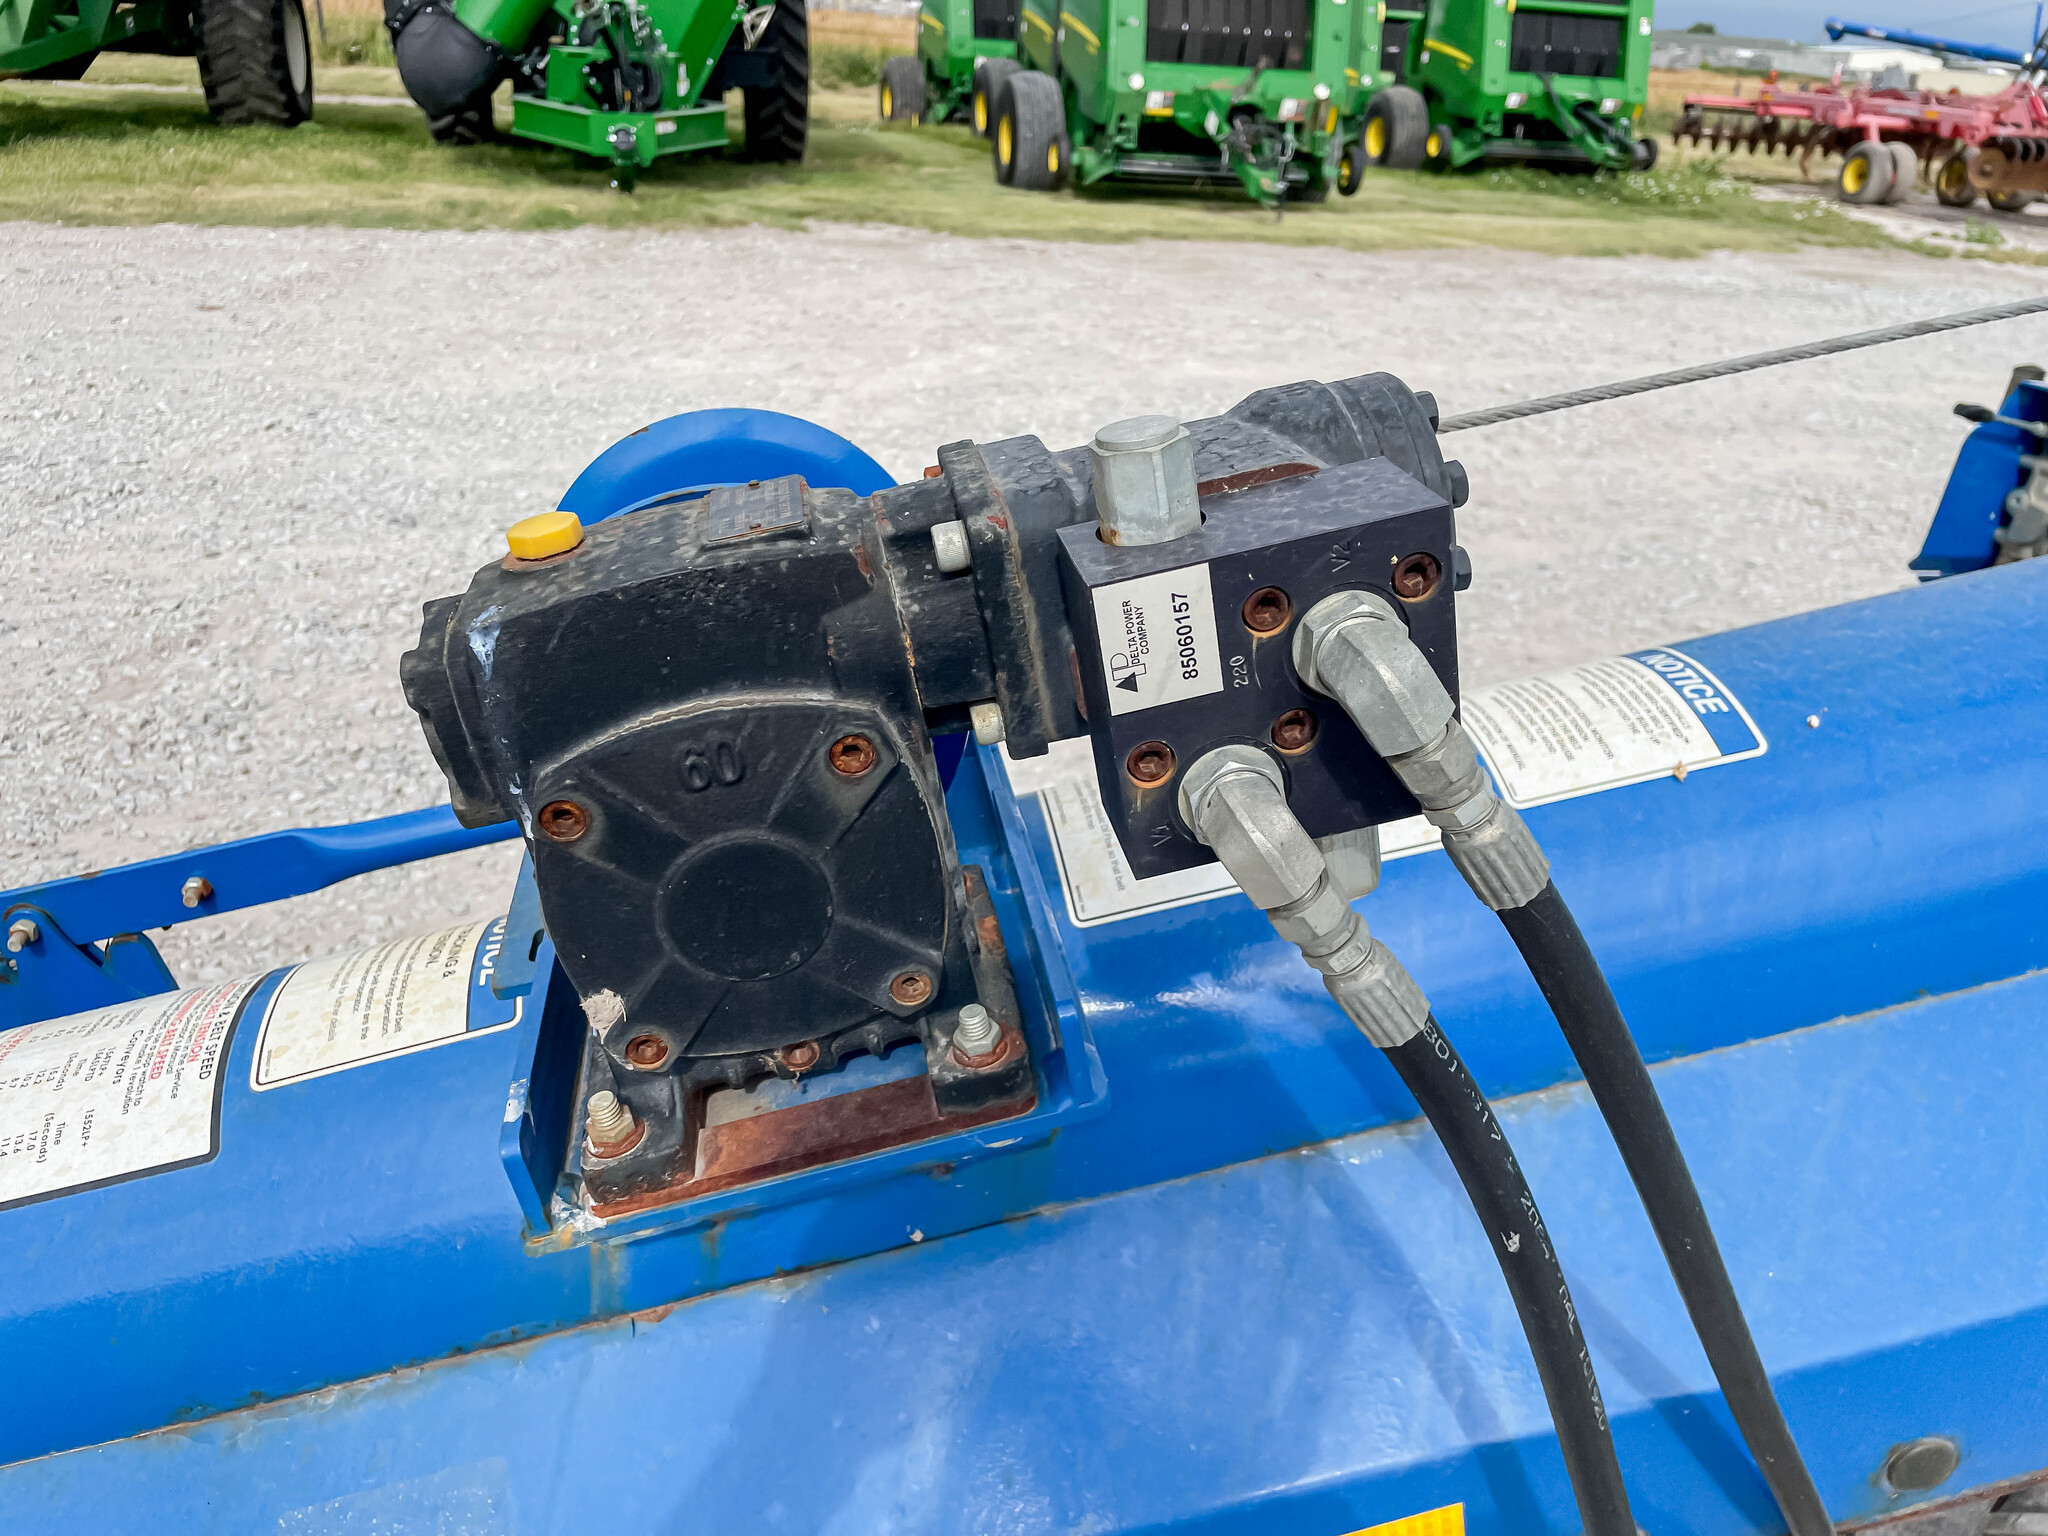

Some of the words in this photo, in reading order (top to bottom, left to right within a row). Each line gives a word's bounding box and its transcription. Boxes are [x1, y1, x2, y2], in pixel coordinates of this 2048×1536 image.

[1122, 599, 1136, 635] POWER
[1134, 606, 1150, 655] COMPANY
[1128, 636, 1141, 665] DELTA
[1171, 593, 1199, 680] 85060157
[1230, 654, 1250, 688] 220
[1639, 652, 1729, 716] NOTICE
[681, 739, 746, 792] 60
[442, 968, 455, 979] &
[159, 1027, 178, 1048] BELT
[186, 1021, 212, 1064] TENSION
[207, 1020, 225, 1042] BELT
[52, 1050, 80, 1092] (Seconds)
[71, 1057, 87, 1077] Time
[111, 1028, 145, 1085] Conveyors
[148, 1048, 169, 1081] SPEED
[198, 1042, 217, 1081] SPEED
[19, 1071, 34, 1088] 10.2
[32, 1068, 47, 1086] 12.2
[121, 1071, 138, 1115] revolution
[134, 1068, 148, 1096] watch
[169, 1066, 184, 1100] Service
[133, 1096, 143, 1107] to
[12, 1133, 24, 1154] 13.6
[26, 1129, 37, 1151] 17.0
[36, 1111, 55, 1164] (Seconds)
[53, 1121, 65, 1146] Time
[80, 1107, 94, 1148] 1552LP+
